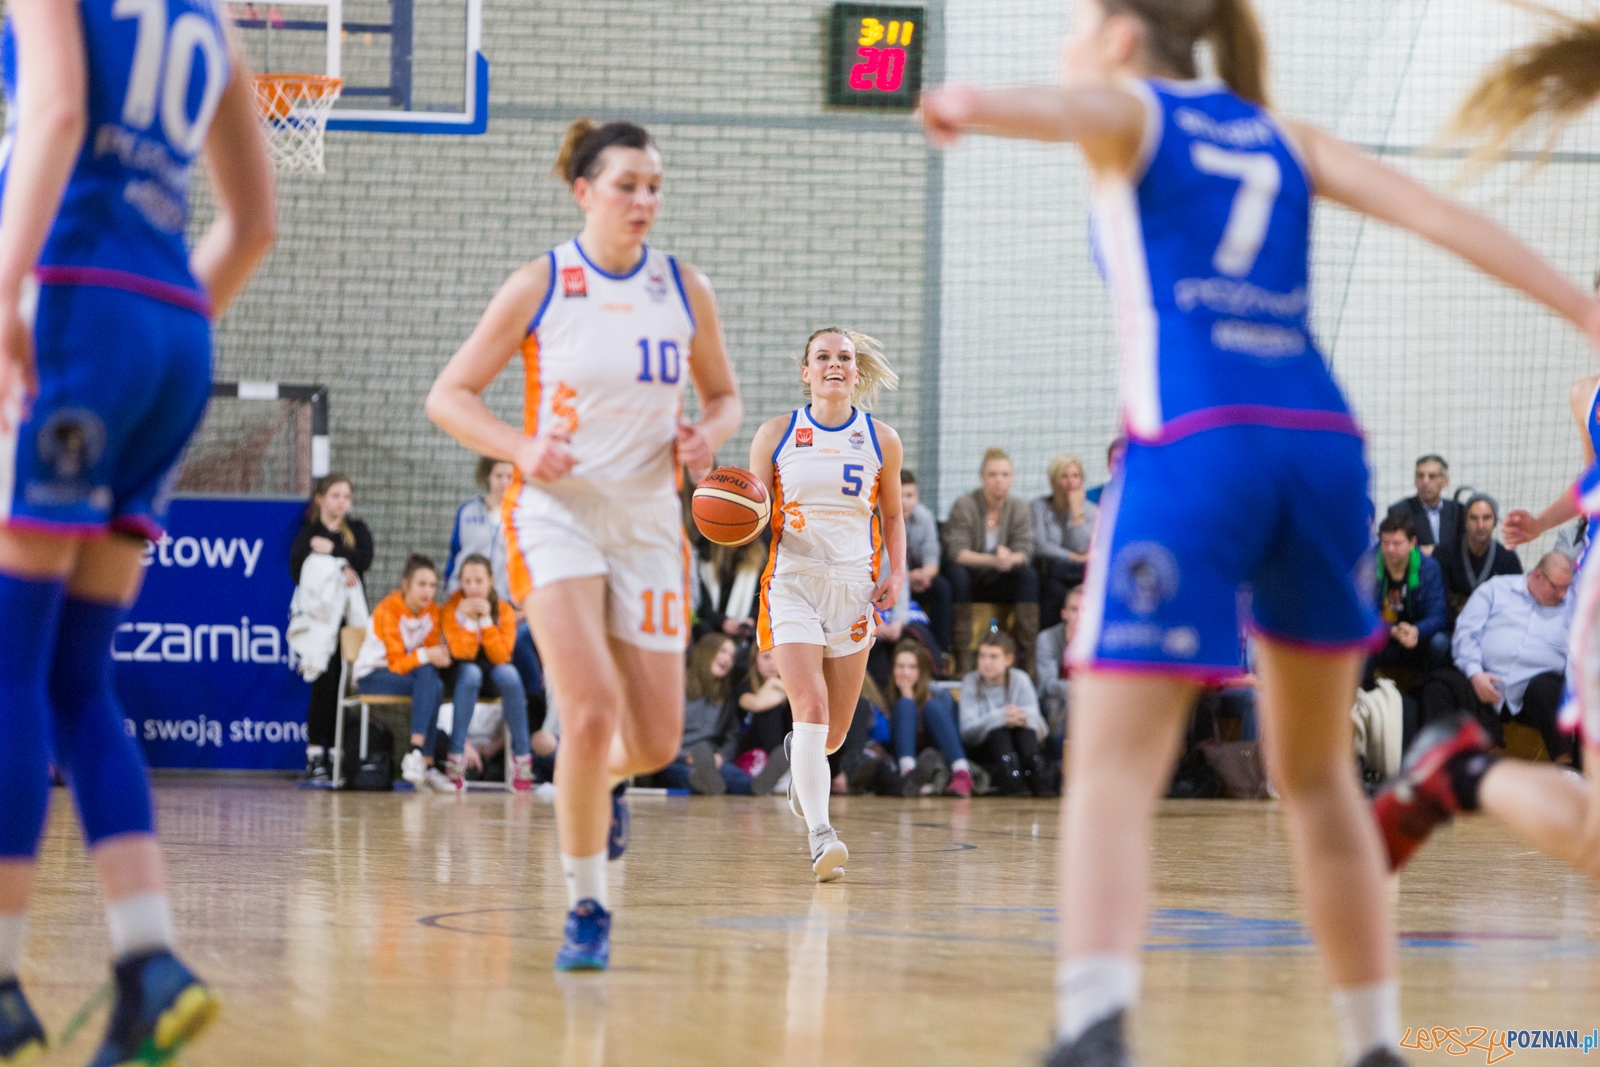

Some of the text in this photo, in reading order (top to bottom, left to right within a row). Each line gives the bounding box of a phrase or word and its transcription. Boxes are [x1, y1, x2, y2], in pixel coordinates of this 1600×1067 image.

[111, 0, 231, 157] 10
[850, 47, 906, 91] 20
[1189, 138, 1281, 278] 7
[638, 338, 680, 384] 10
[706, 473, 748, 490] molten
[841, 463, 864, 497] 5
[143, 714, 223, 747] swoją
